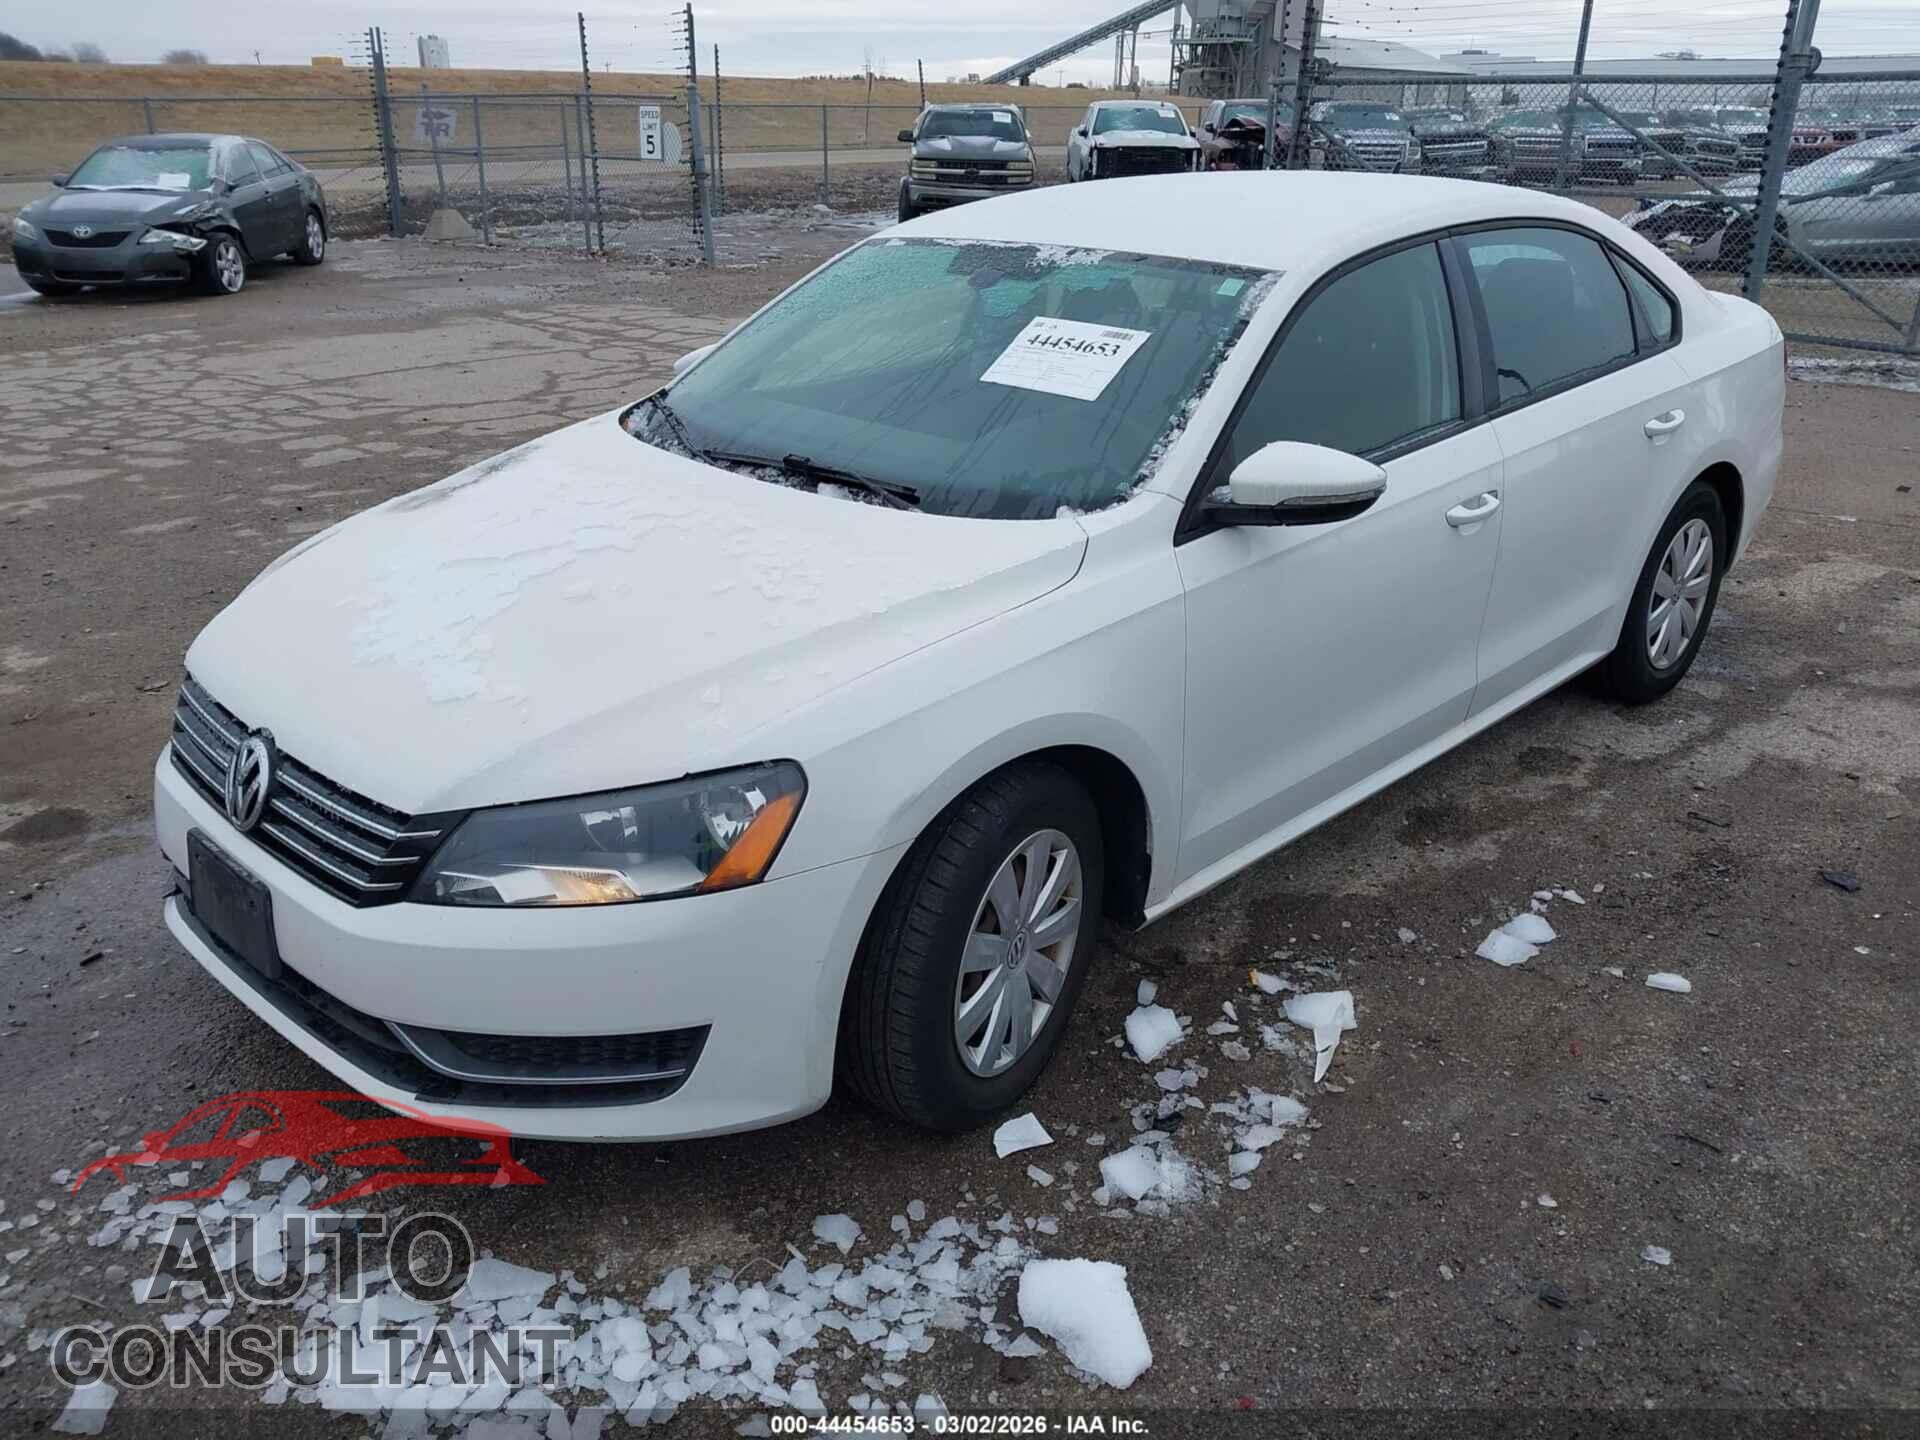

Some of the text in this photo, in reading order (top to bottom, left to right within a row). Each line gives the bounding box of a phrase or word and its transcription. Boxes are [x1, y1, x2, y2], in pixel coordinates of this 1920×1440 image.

[640, 110, 658, 119] SPEED
[642, 122, 657, 131] LIMIT
[646, 134, 656, 155] 5
[1026, 333, 1121, 357] 44454653
